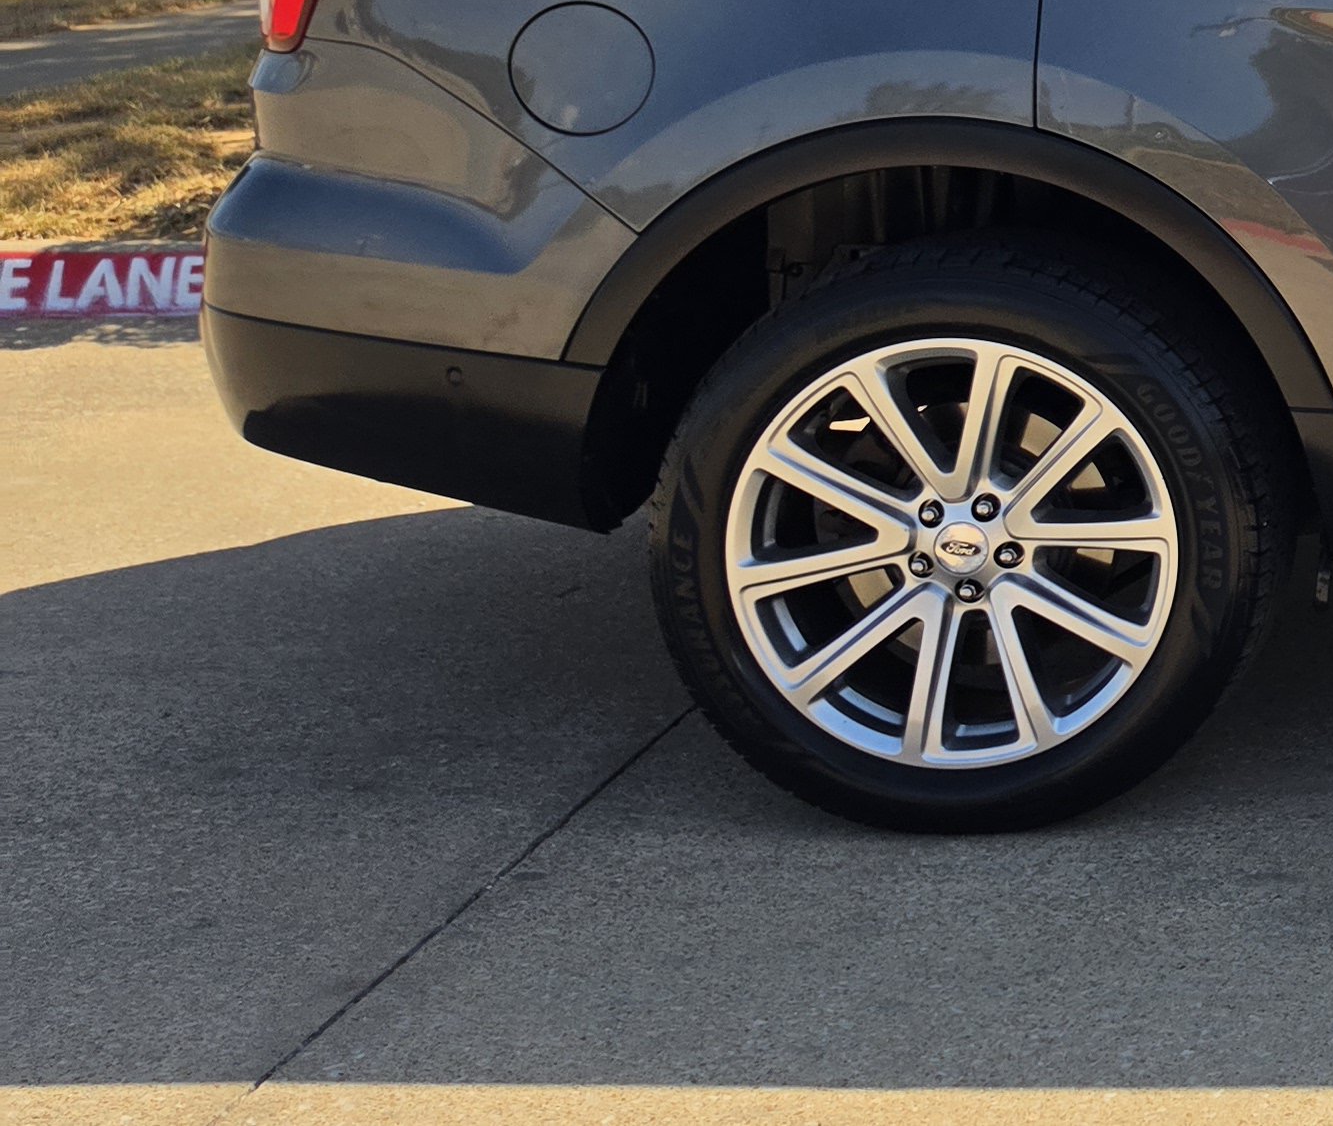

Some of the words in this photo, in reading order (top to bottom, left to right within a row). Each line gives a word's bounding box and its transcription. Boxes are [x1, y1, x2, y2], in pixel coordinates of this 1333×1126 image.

[45, 256, 205, 310] LANE
[1136, 382, 1225, 591] GOODYEAR
[946, 541, 976, 556] Ford
